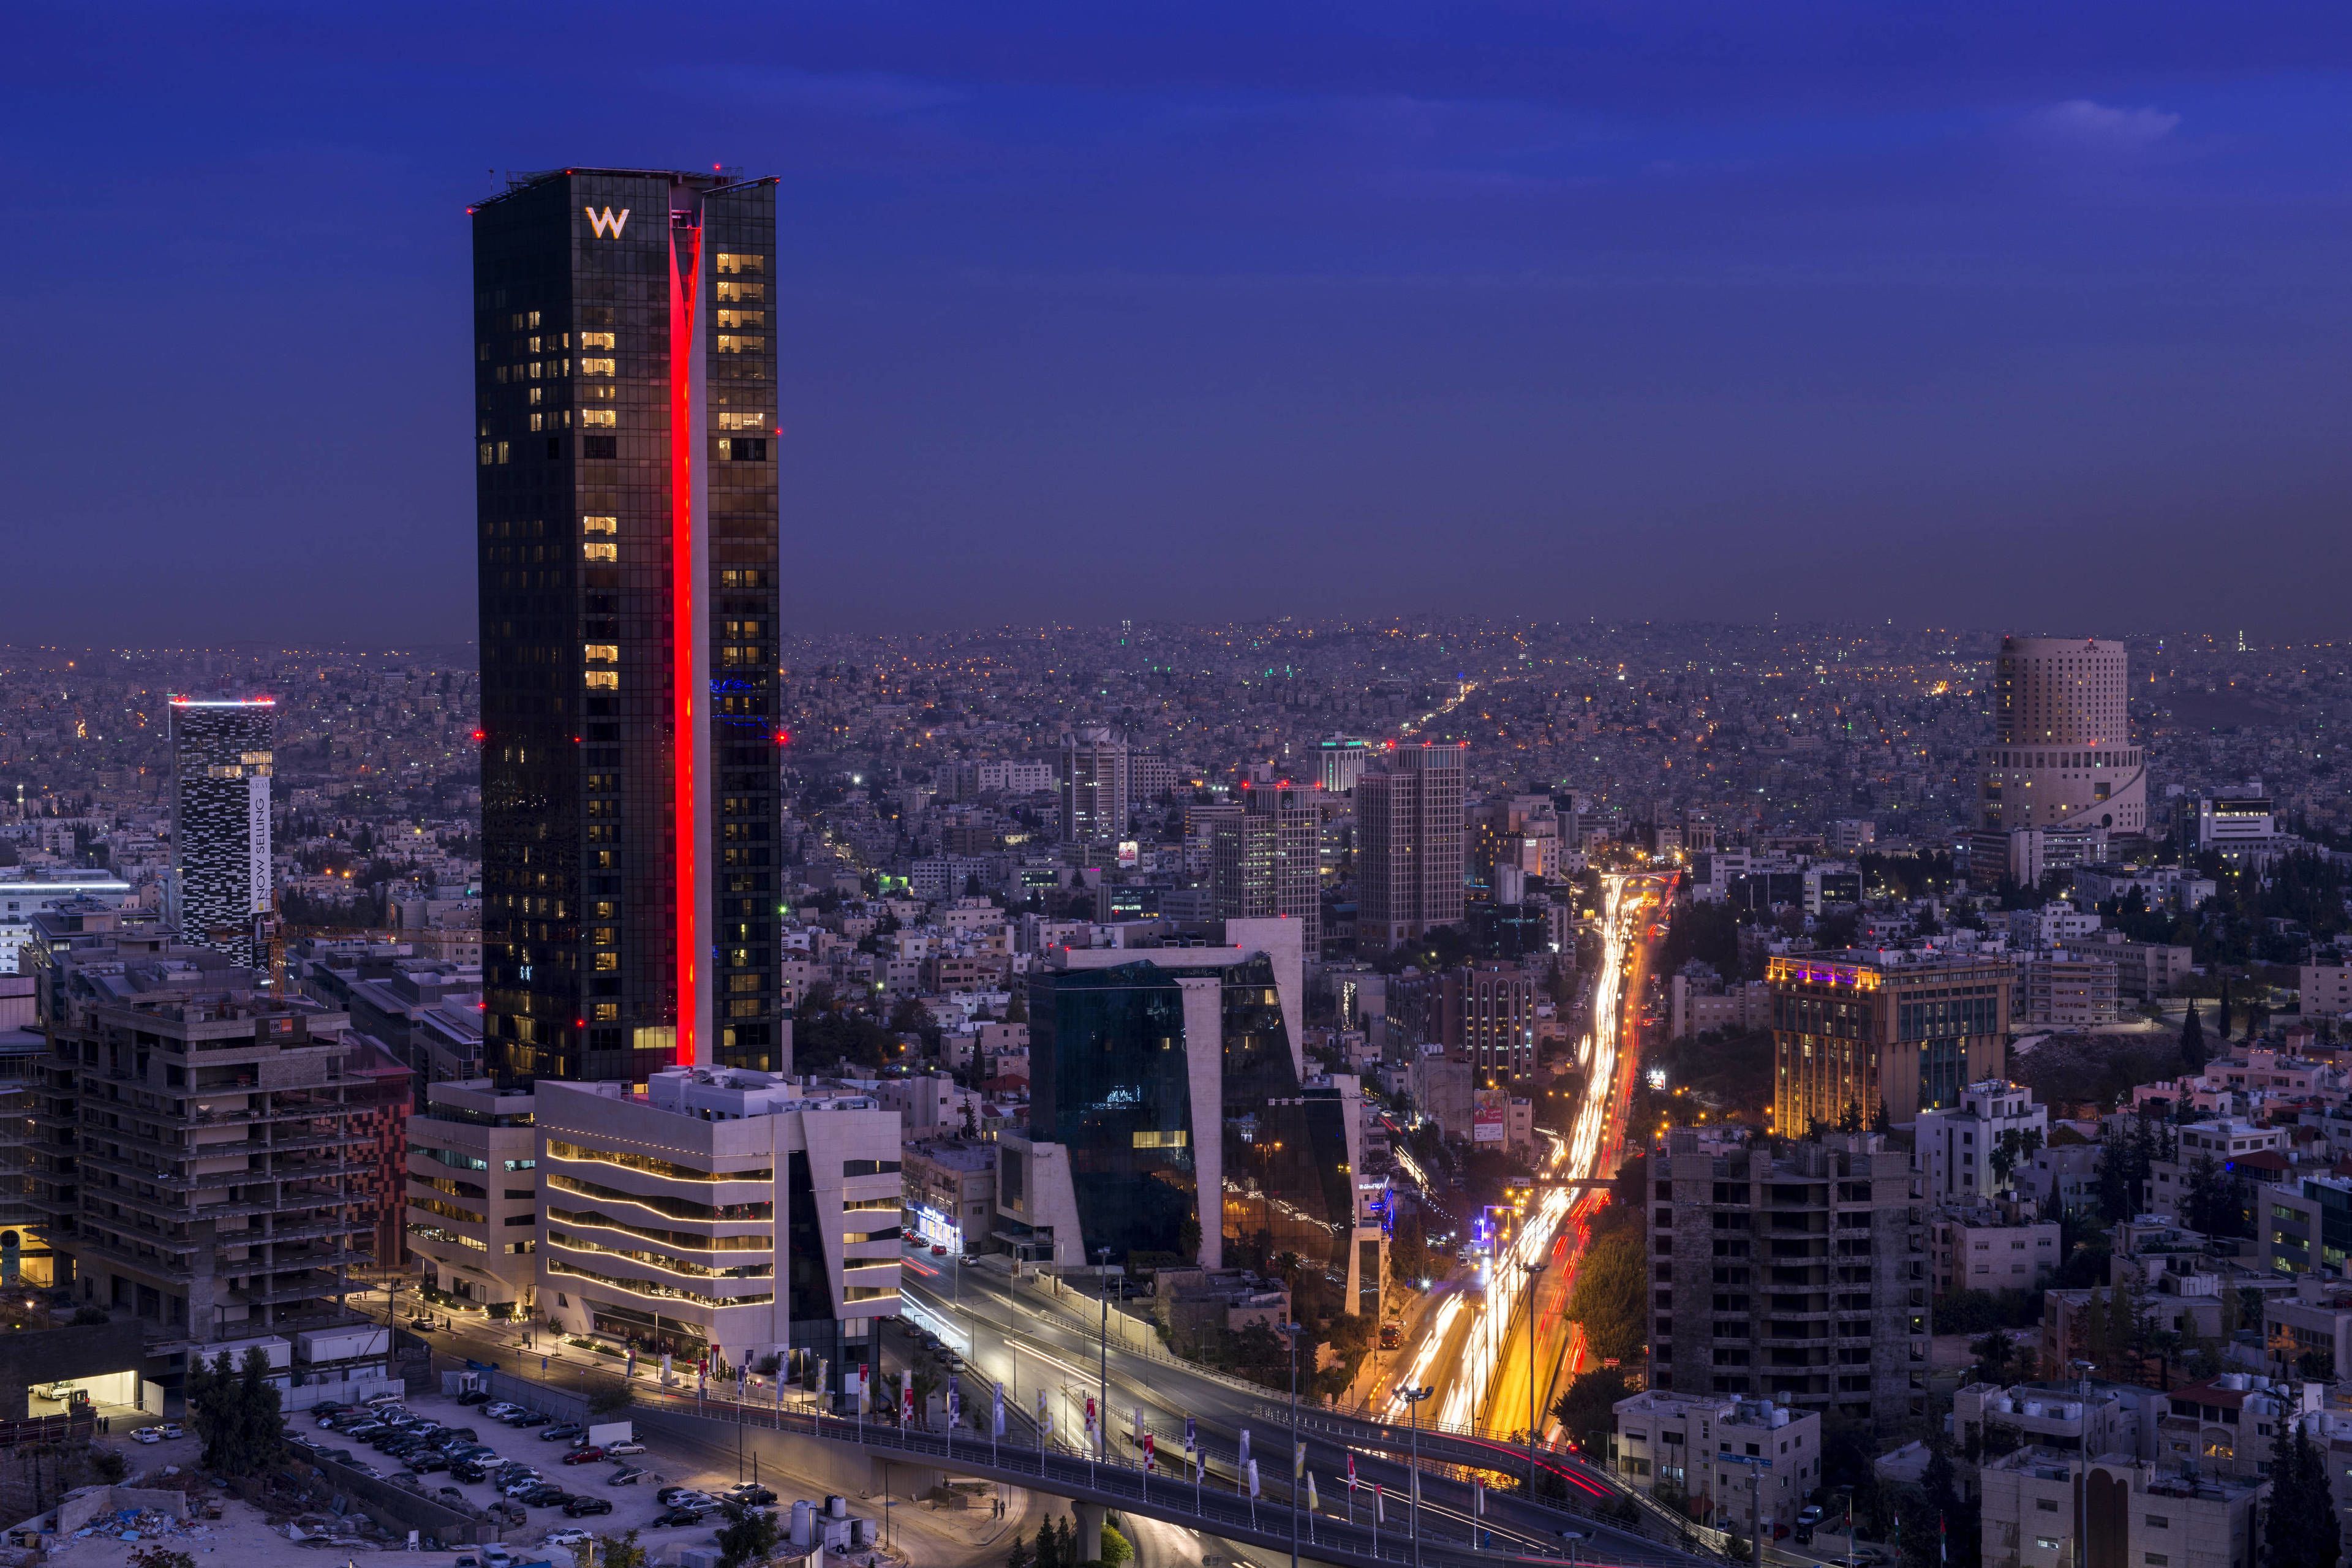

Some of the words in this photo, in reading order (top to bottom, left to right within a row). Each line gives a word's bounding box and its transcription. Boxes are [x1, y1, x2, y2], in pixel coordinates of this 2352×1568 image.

[585, 206, 630, 239] W
[255, 798, 265, 854] SELLING
[256, 860, 265, 900] NOW
